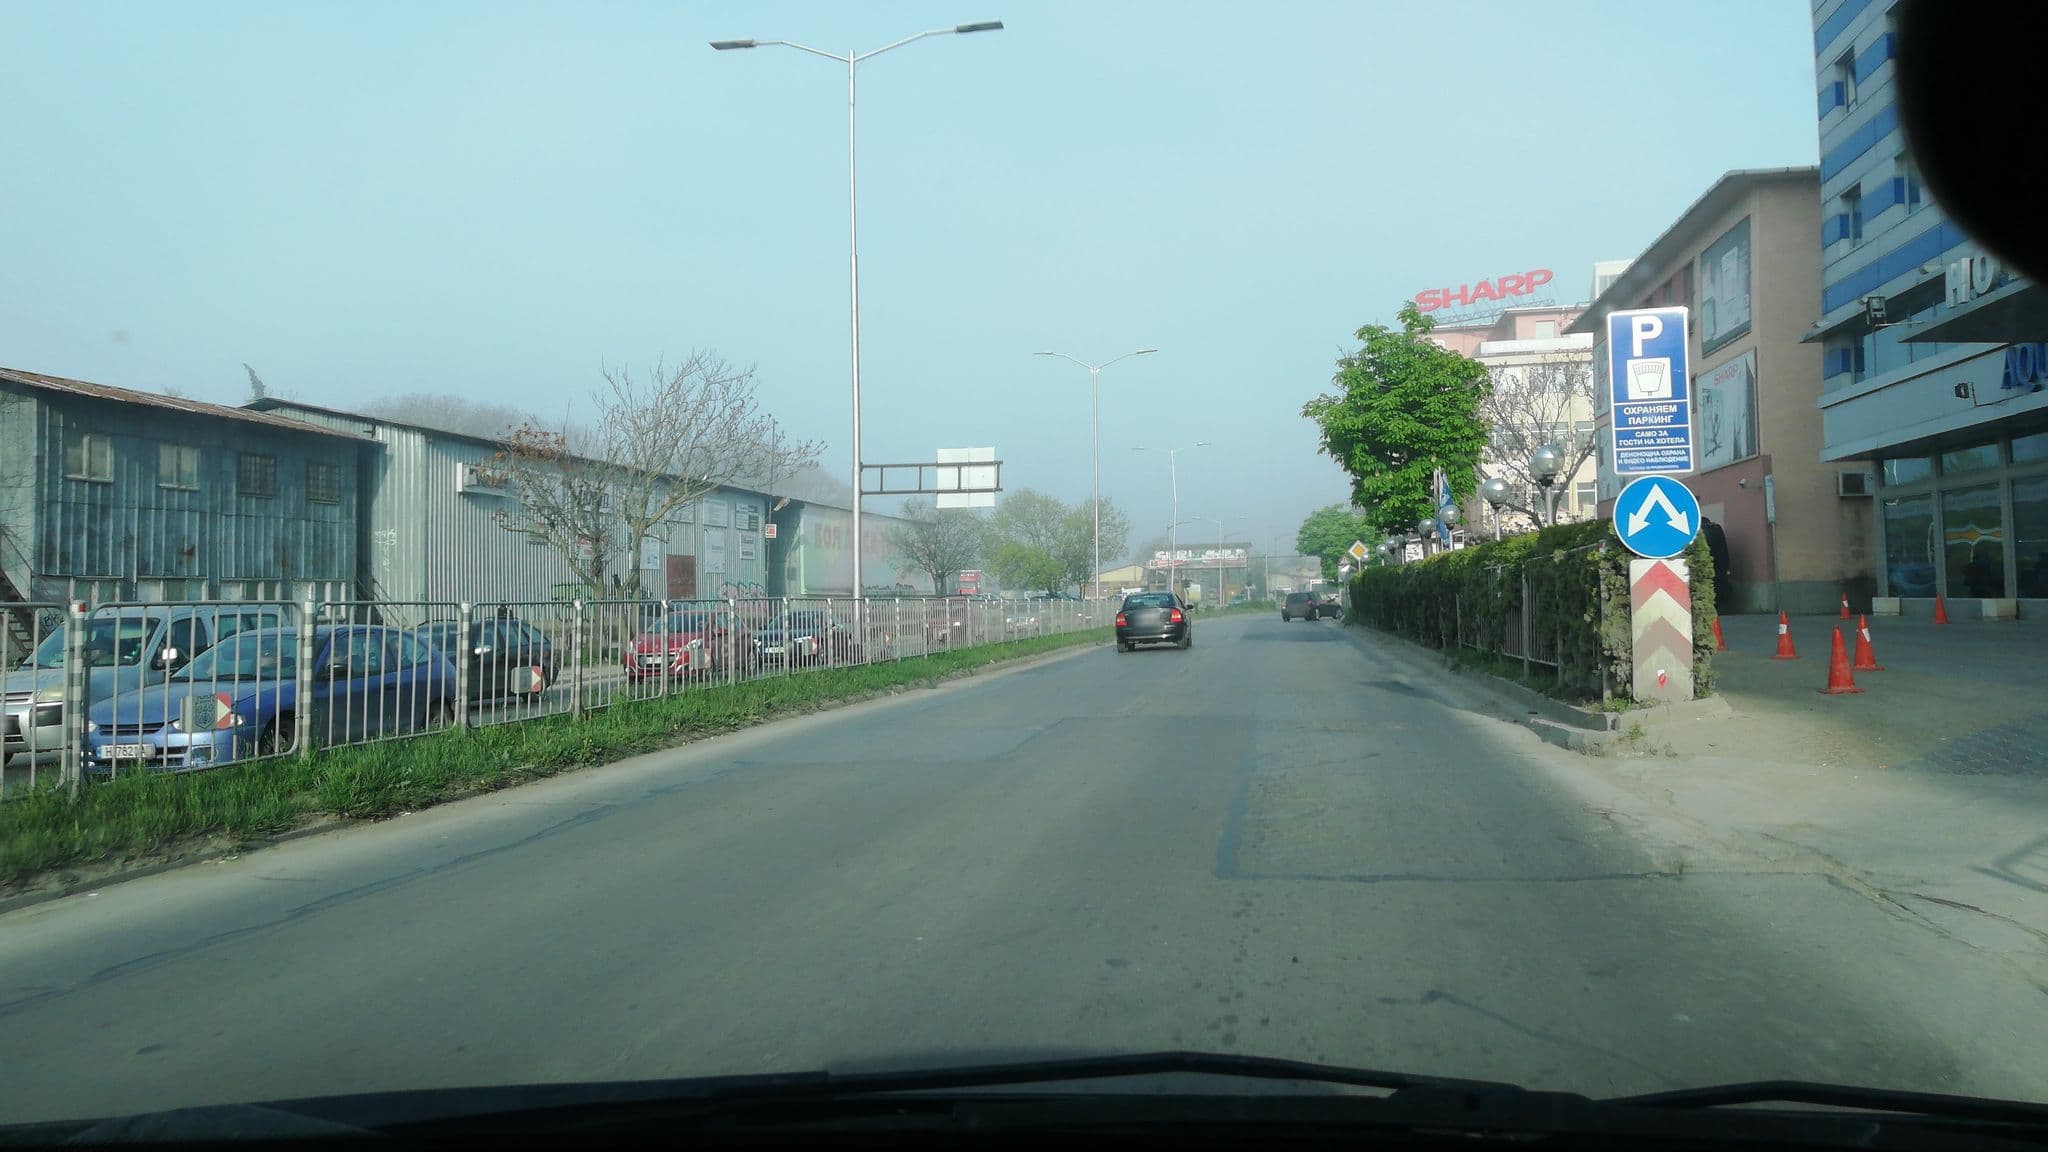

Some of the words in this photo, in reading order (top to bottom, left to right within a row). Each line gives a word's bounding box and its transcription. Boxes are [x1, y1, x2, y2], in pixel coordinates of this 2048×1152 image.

[1414, 269, 1553, 313] SHARP
[1945, 255, 2001, 308] HO
[1632, 315, 1663, 357] P
[1713, 363, 1738, 385] SHARP
[1623, 404, 1677, 415] ОХРАНЯЕМ
[1628, 415, 1674, 425] ПАРКИНГ
